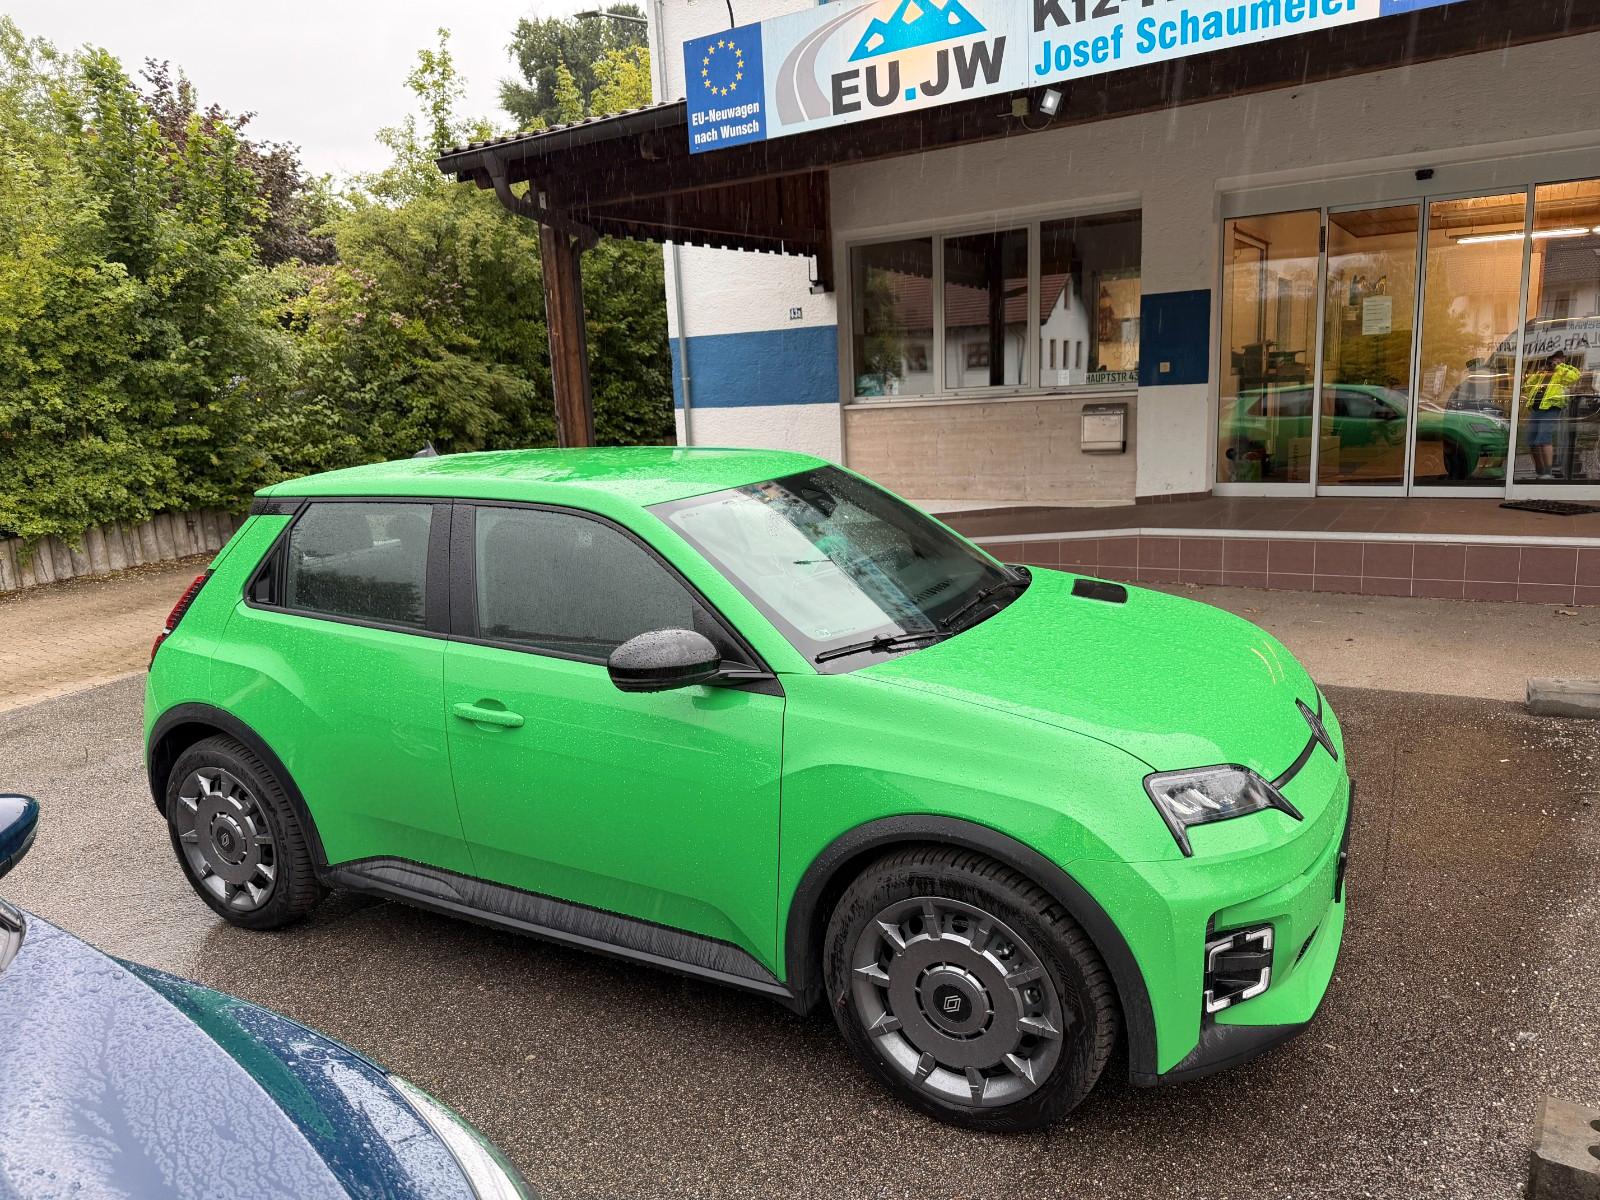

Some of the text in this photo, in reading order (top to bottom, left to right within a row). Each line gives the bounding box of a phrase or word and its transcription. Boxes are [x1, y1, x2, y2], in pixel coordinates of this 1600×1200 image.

[1034, 24, 1124, 76] Josef
[831, 35, 1007, 116] EU.JW
[691, 102, 760, 126] EU-Neuwagen
[694, 119, 760, 144] nach Wunsch
[1085, 372, 1127, 383] HAUPTSTR
